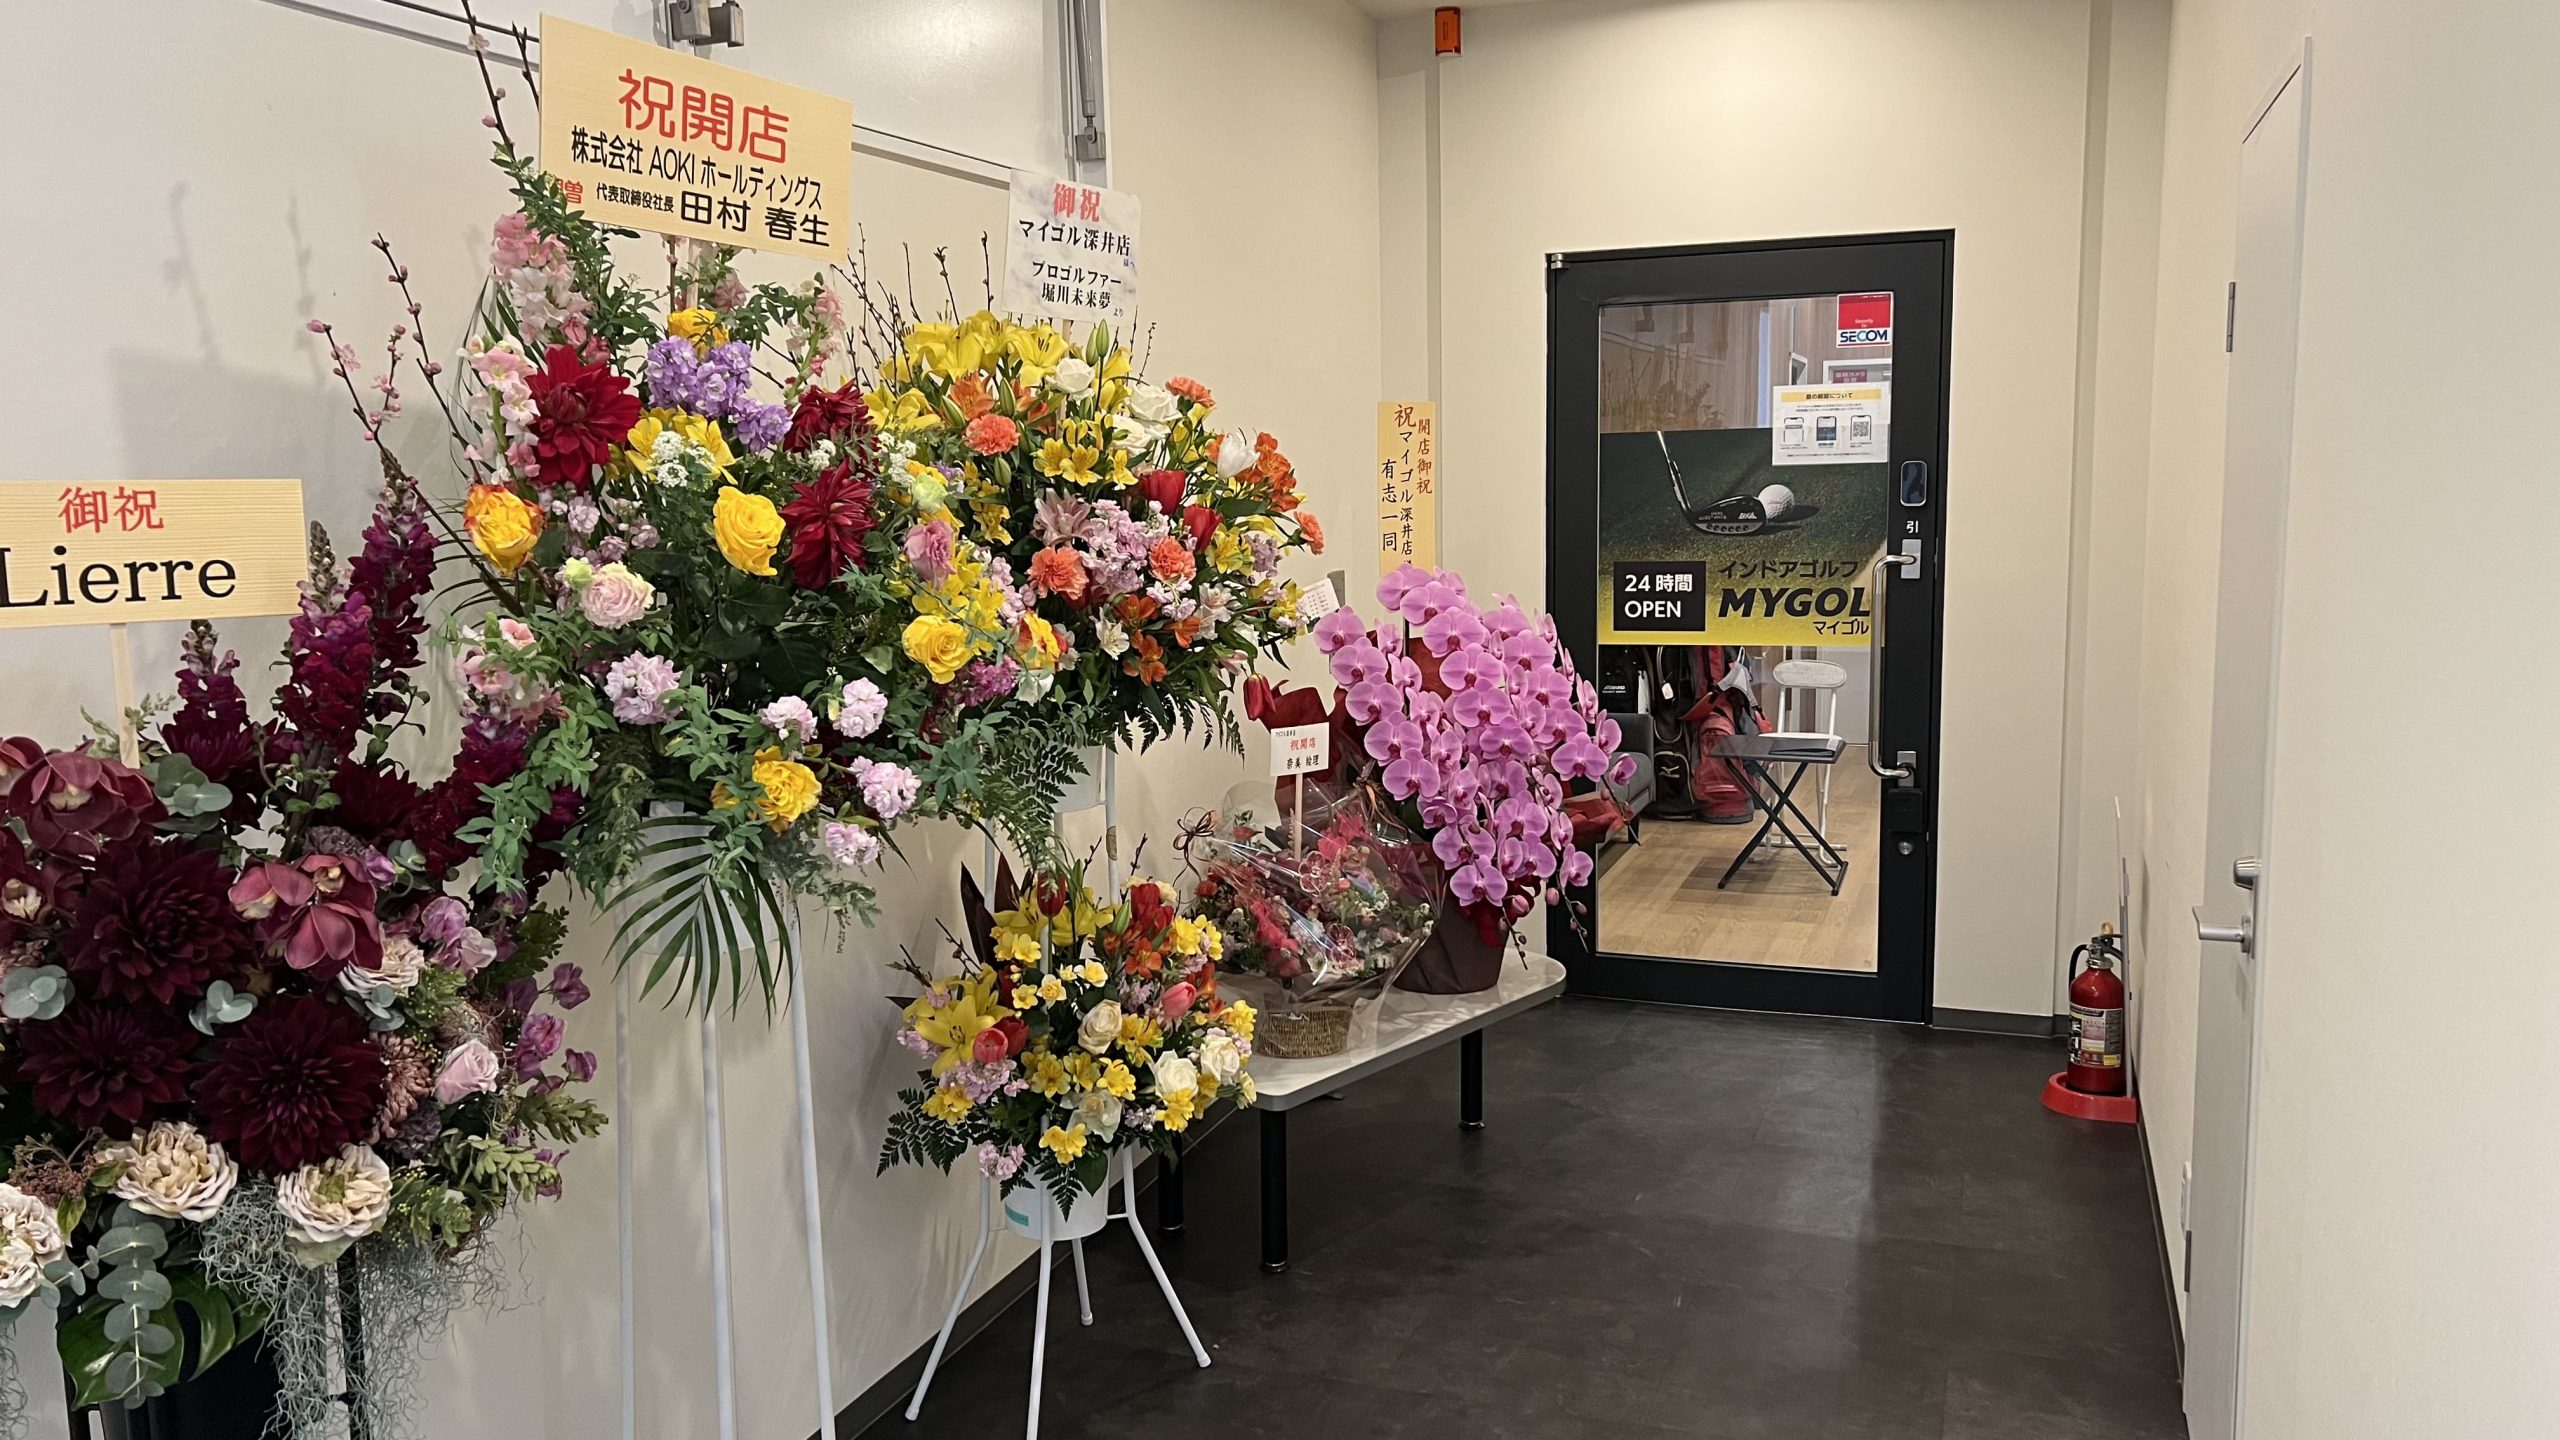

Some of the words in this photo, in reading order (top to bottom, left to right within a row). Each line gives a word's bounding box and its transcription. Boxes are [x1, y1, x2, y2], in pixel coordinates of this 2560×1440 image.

[617, 68, 790, 164] 祝開店
[571, 125, 644, 175] 株式会社
[648, 146, 696, 185] AOKI
[700, 156, 823, 210] ホールディングス
[596, 182, 675, 214] 代表取締役社長
[680, 190, 751, 232] 田村
[764, 206, 830, 247] 春生
[1052, 182, 1101, 223] 御祝
[1018, 219, 1131, 257] マイゴル深井店
[1032, 260, 1122, 287] プロゴルファー
[1840, 329, 1888, 343] SECOM
[1394, 404, 1416, 428] 祝
[1416, 418, 1433, 494] 開店御祝
[57, 486, 165, 533] 御祝
[1381, 459, 1398, 552] 有志一同
[1399, 431, 1414, 564] マイゴル深井店
[1906, 520, 1919, 534] 引
[0, 545, 236, 608] Lierre
[1624, 574, 1650, 592] 24
[1655, 573, 1693, 593] 時間
[1718, 560, 1859, 579] インドアゴルフ
[1624, 600, 1681, 618] OPEN
[1717, 587, 1871, 618] MYGOL
[1813, 618, 1870, 635] マイゴル
